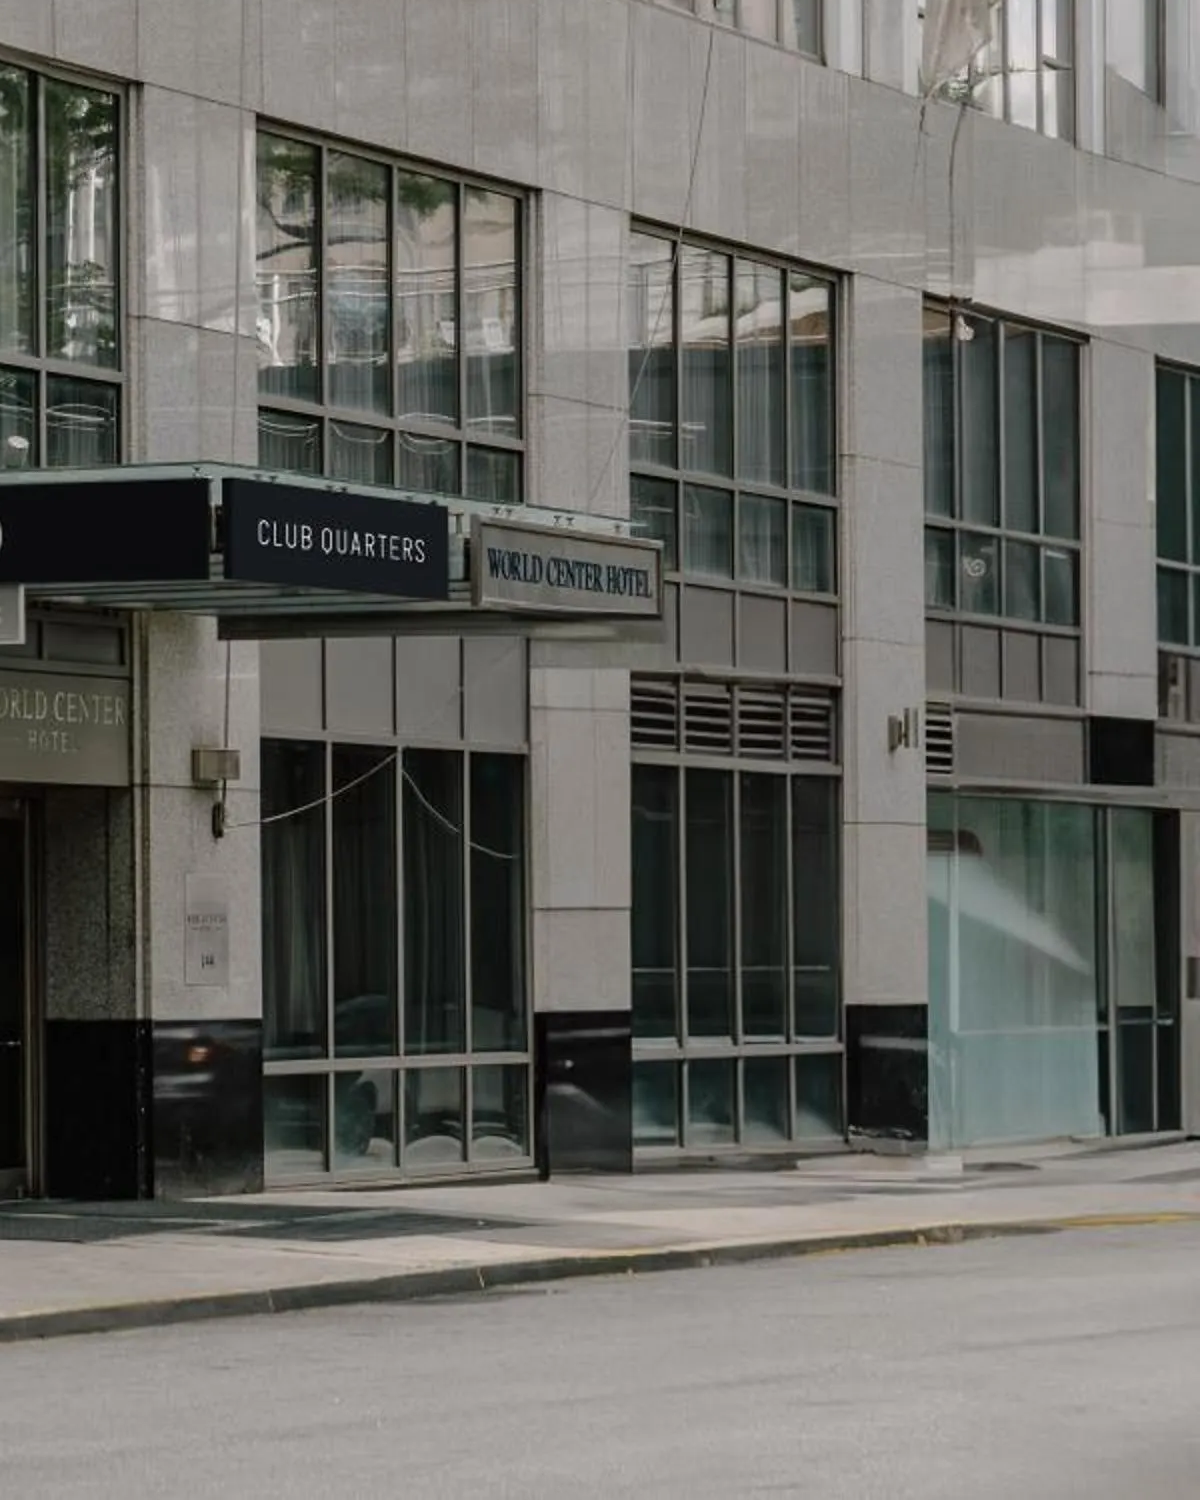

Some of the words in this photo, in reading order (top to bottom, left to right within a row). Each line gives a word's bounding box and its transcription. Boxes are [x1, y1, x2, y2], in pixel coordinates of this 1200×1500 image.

[257, 519, 313, 550] CLUB
[320, 527, 426, 563] QUARTERS
[487, 547, 543, 584] WORLD
[545, 556, 604, 593] CENTER
[605, 565, 652, 598] HOTEL
[53, 691, 124, 725] CENTER
